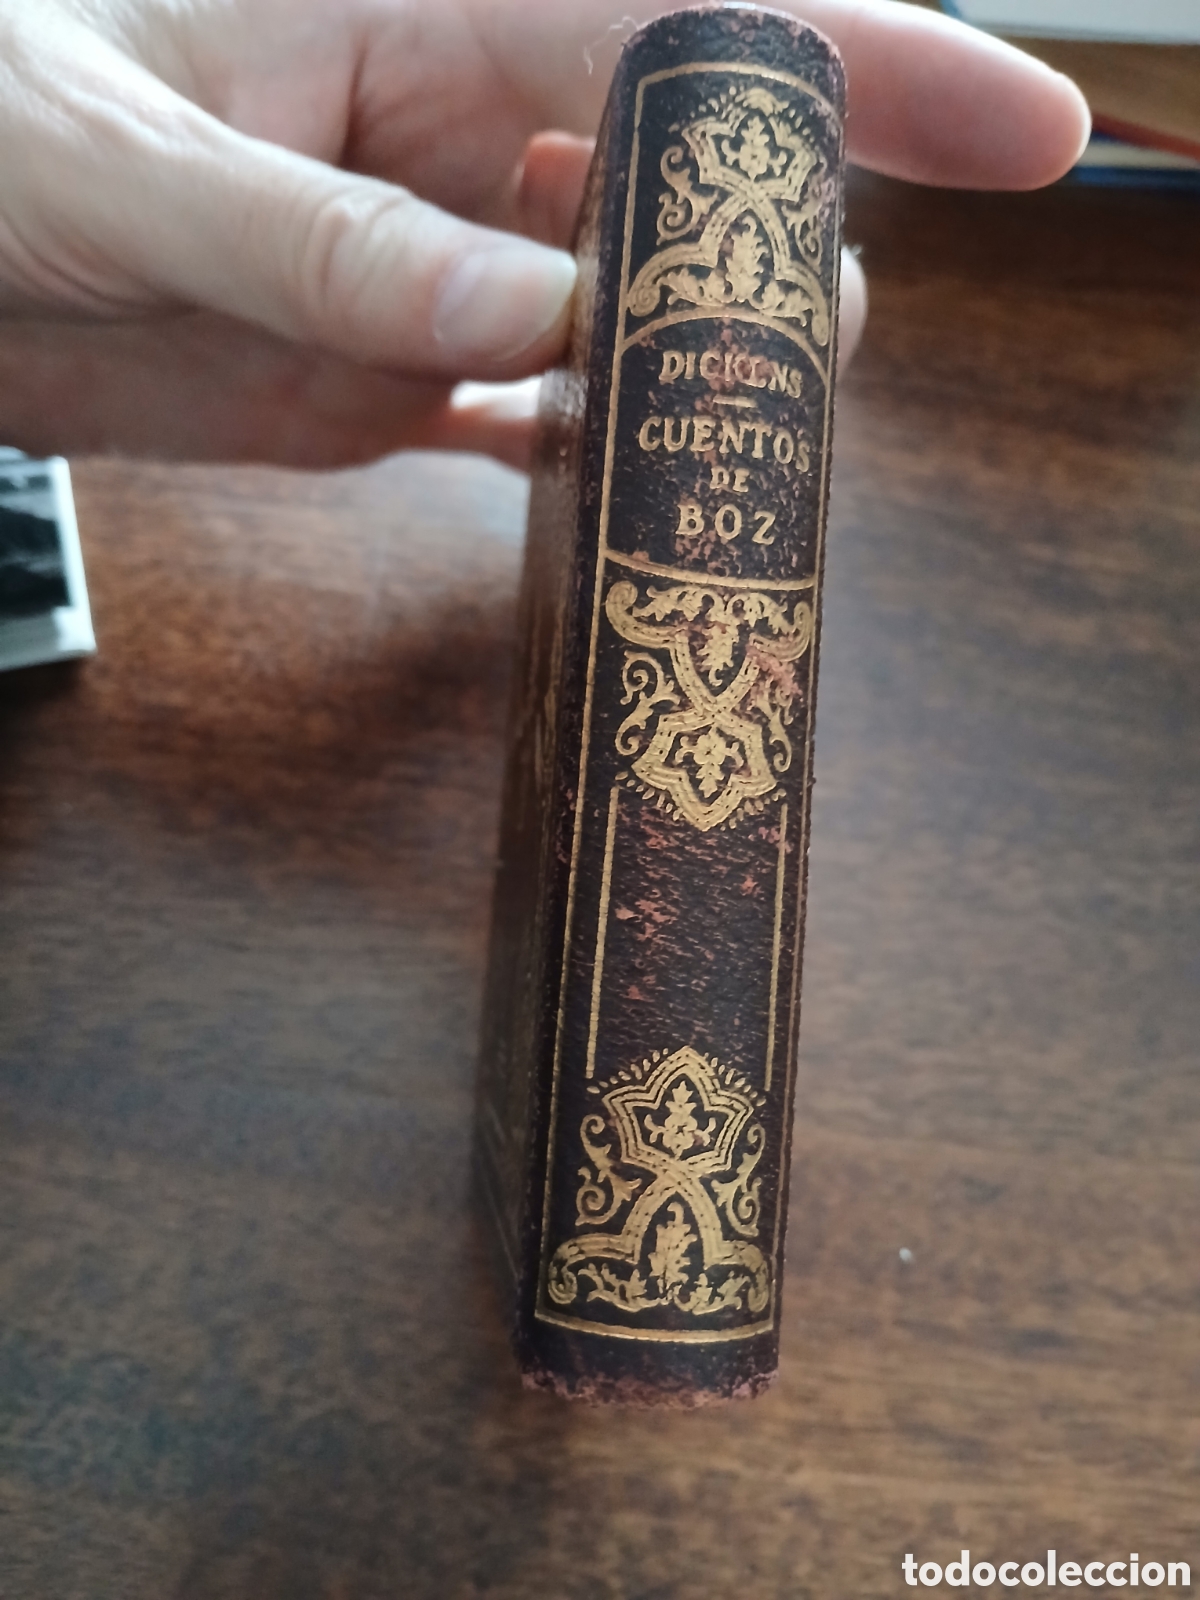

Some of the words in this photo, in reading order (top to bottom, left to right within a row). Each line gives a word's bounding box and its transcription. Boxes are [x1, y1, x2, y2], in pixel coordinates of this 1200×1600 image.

[638, 416, 811, 472] CUENTOS
[710, 466, 750, 493] DE
[676, 504, 776, 545] BOZ
